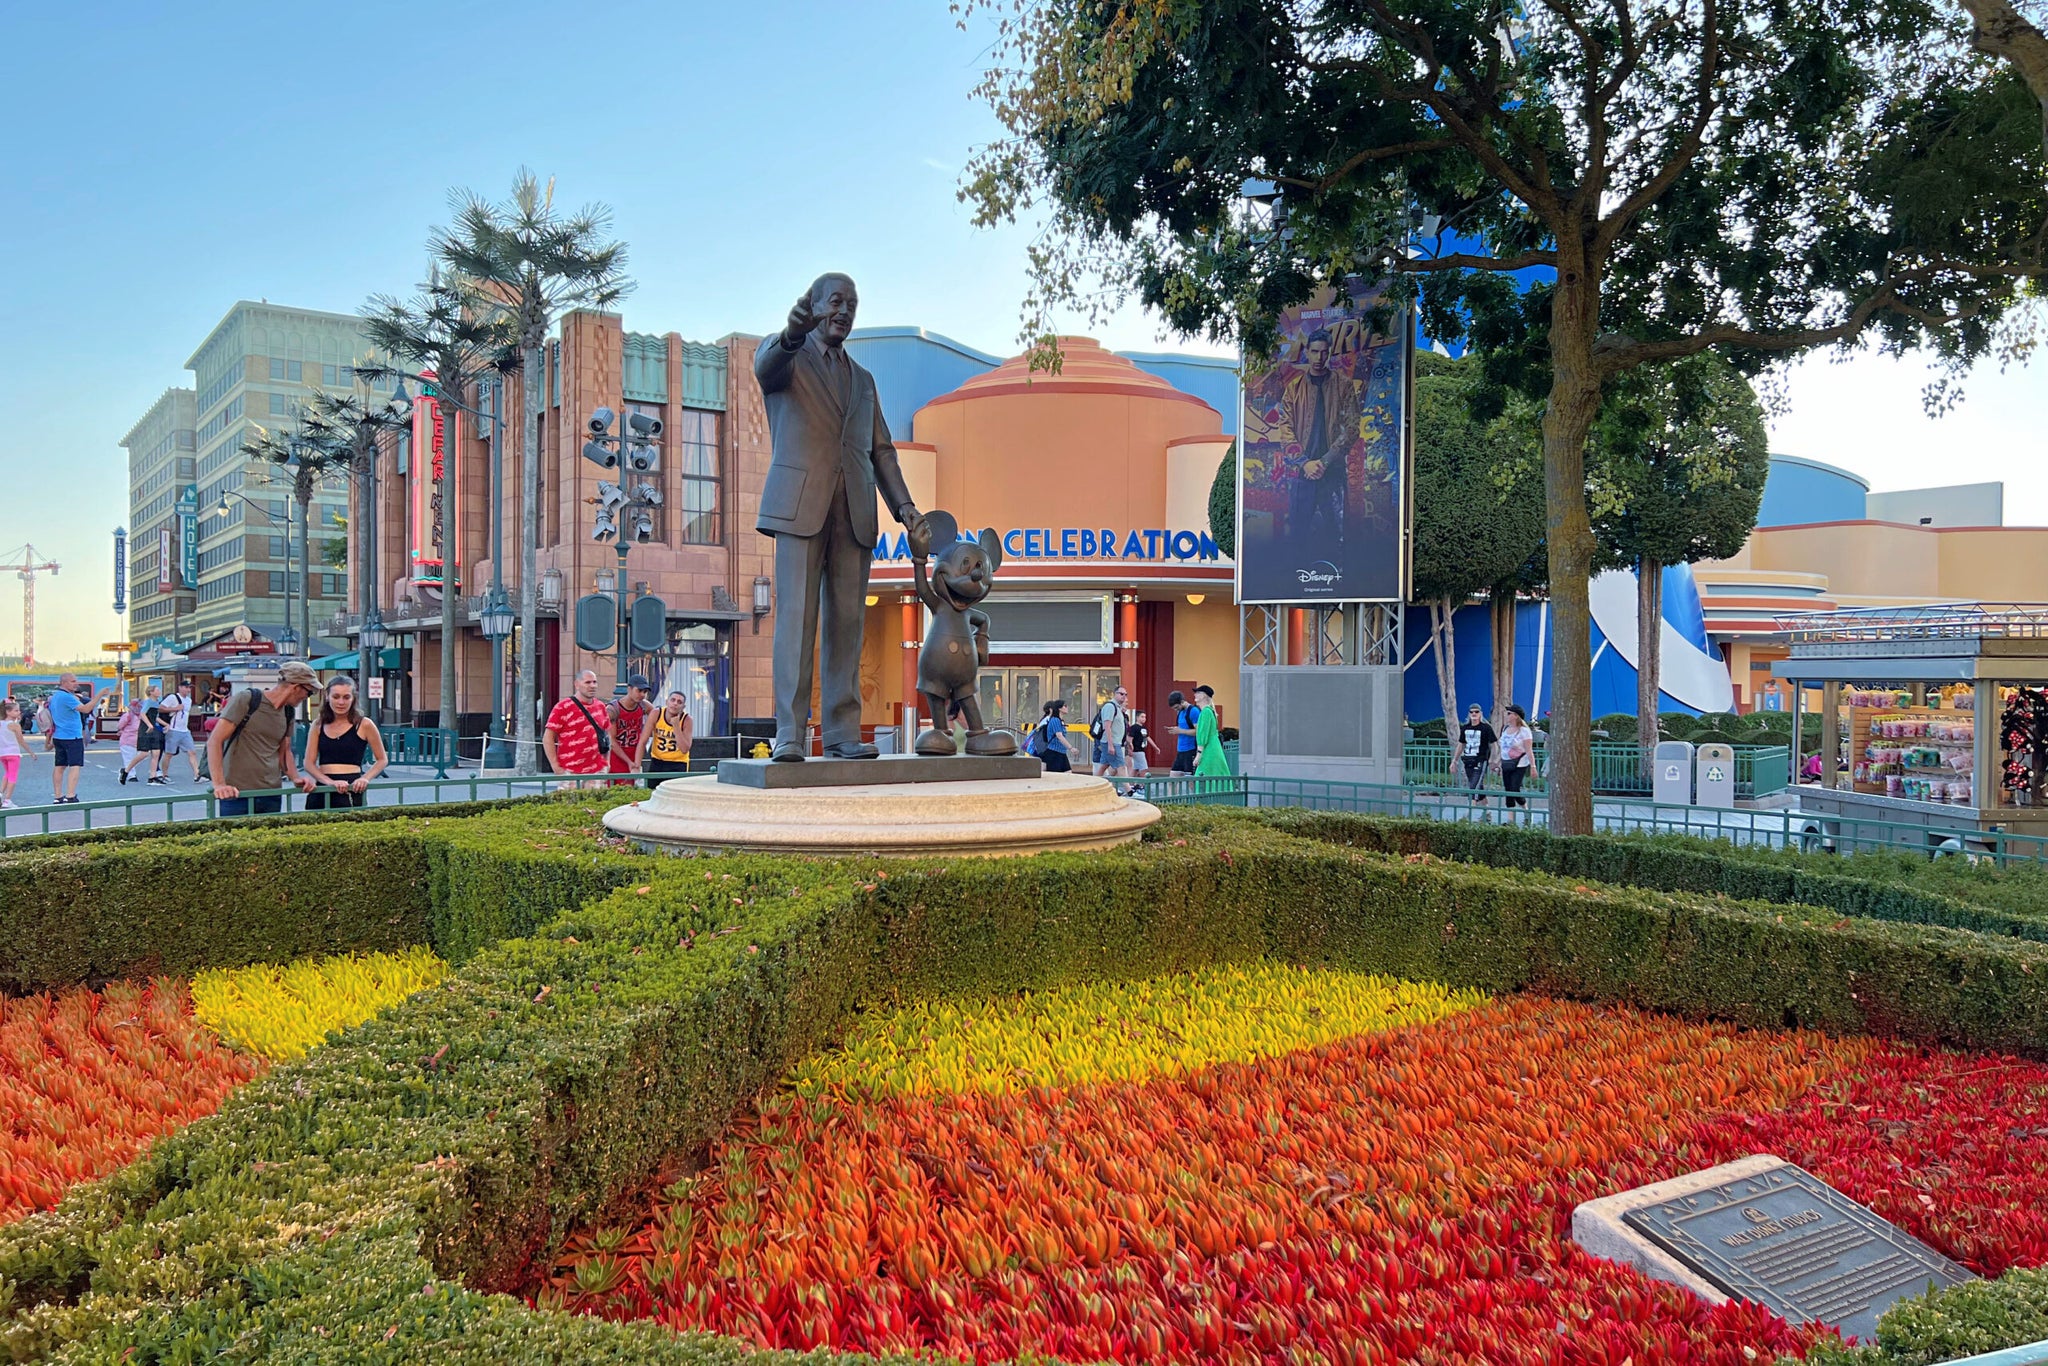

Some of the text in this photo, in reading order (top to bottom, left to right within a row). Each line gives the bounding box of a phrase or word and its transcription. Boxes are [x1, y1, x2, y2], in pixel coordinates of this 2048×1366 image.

[1301, 308, 1344, 320] MARVEL STUDIOS
[187, 518, 195, 583] HOTEL
[1003, 528, 1219, 560] CELEBRATION
[116, 538, 124, 601] LARCHMONT
[616, 730, 639, 748] 42
[655, 728, 676, 739] ATLAN
[1719, 1230, 1753, 1249] WALT
[1746, 1219, 1786, 1240] DISNEY
[1780, 1208, 1824, 1229] STUDIOS
